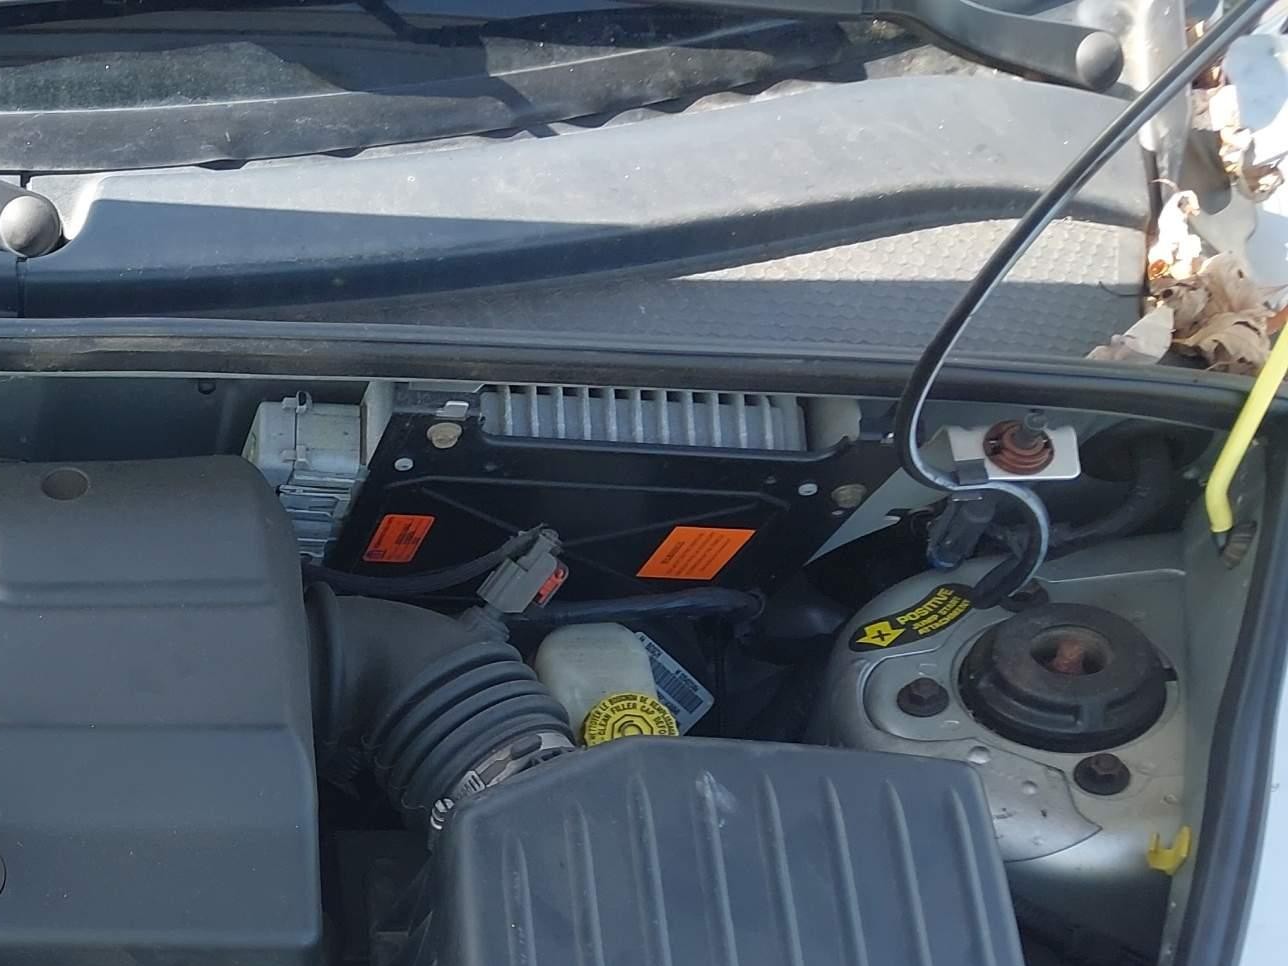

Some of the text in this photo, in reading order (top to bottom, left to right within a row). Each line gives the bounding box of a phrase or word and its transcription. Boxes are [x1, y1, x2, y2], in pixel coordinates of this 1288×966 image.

[896, 587, 955, 625] POSITIVE
[912, 596, 963, 630] JUMP START
[598, 712, 612, 736] CLEAN
[611, 703, 638, 714] FILLER
